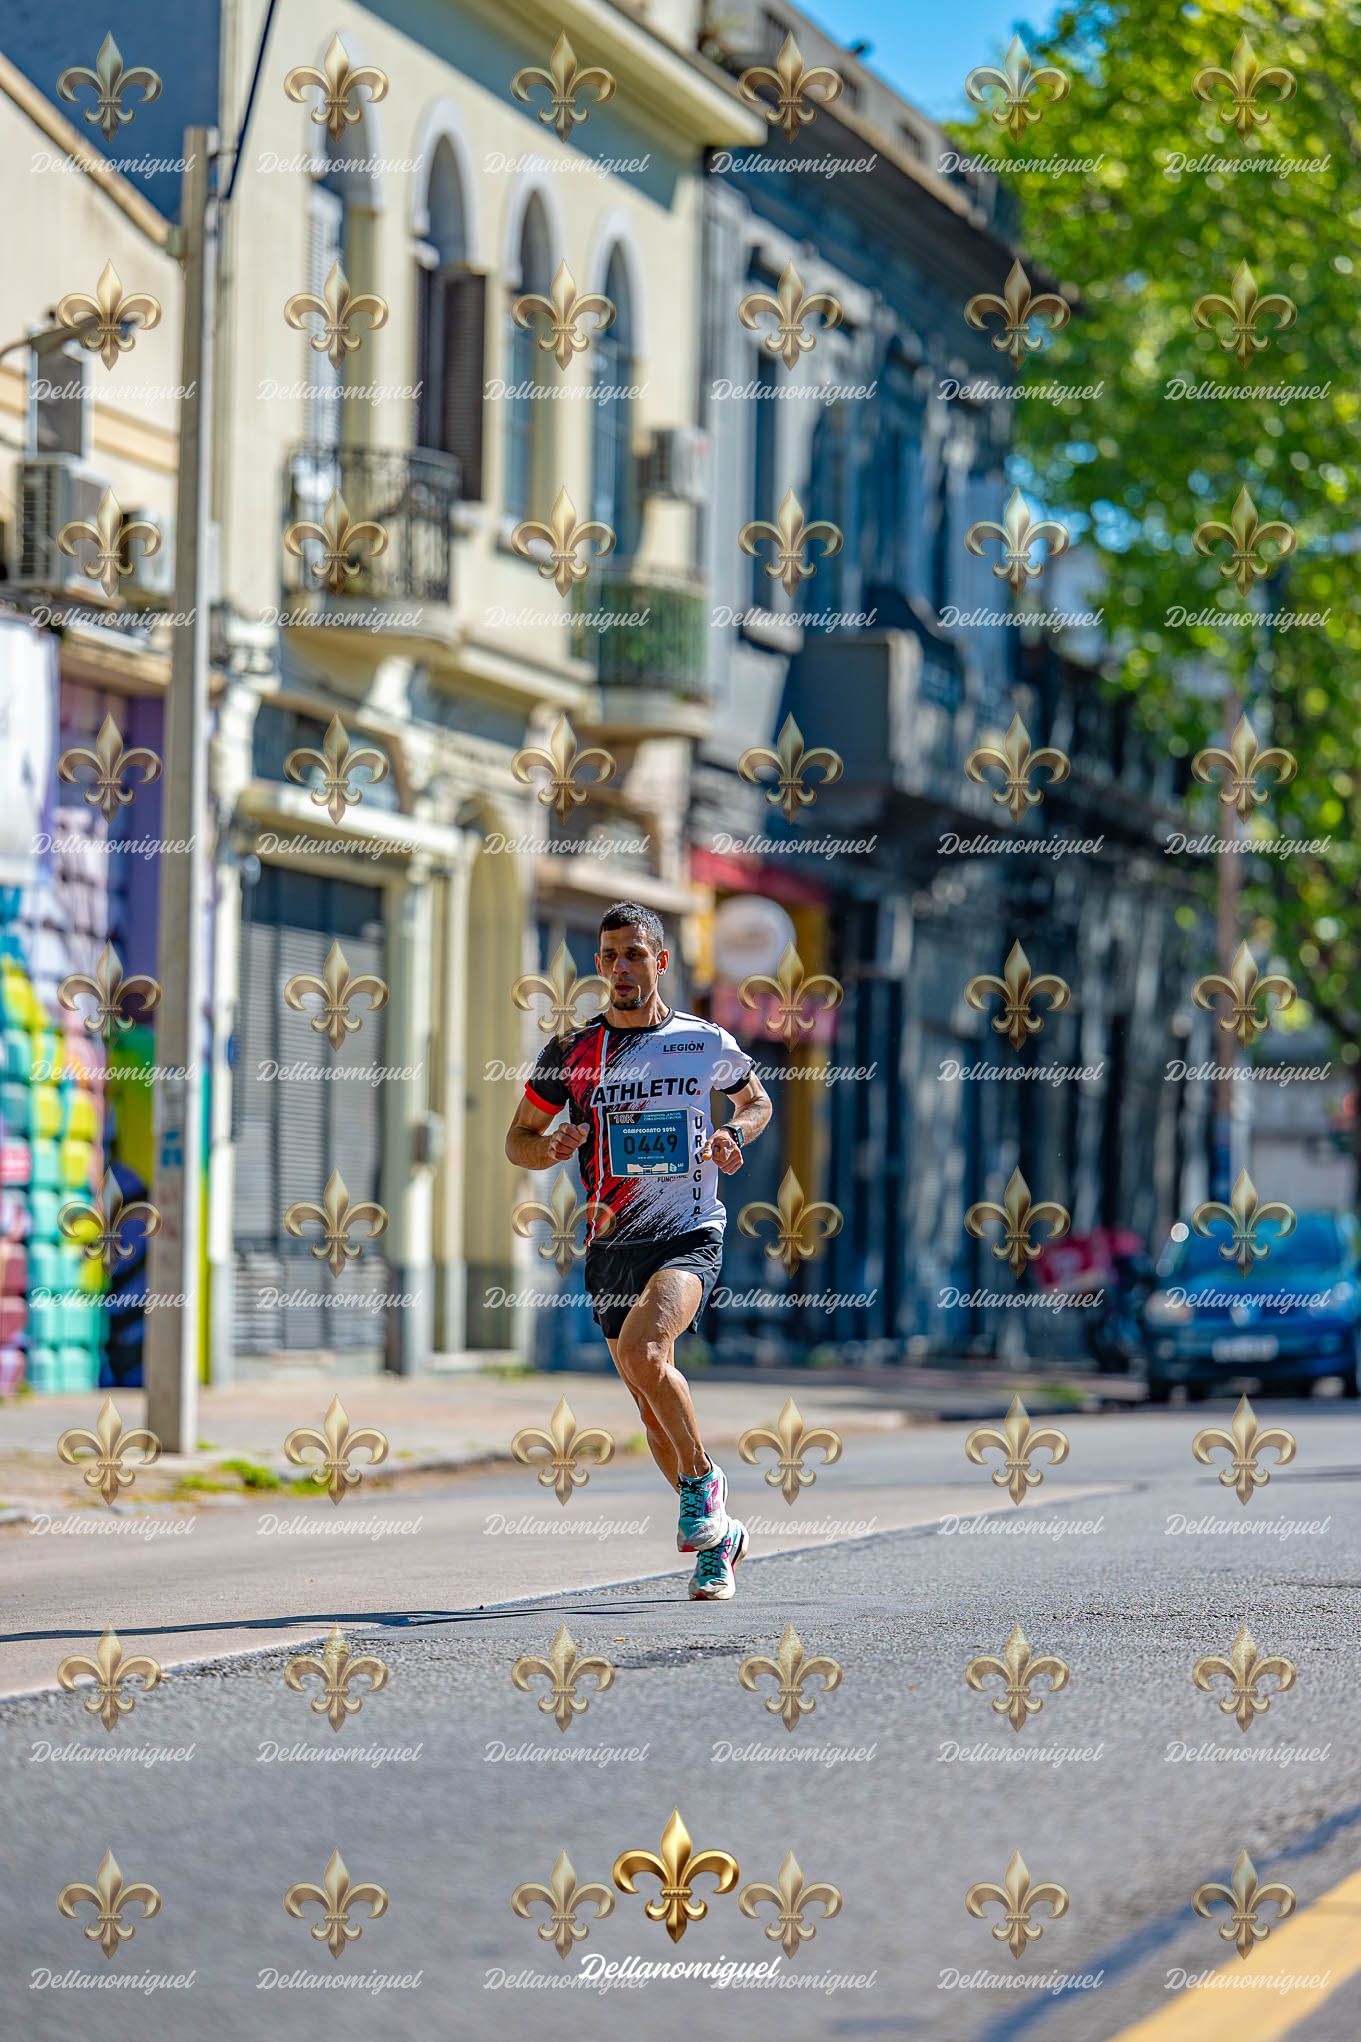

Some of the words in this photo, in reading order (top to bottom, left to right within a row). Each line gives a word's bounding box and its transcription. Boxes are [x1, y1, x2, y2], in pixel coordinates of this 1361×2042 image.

[613, 1114, 636, 1125] 10K
[623, 1133, 678, 1155] 0449
[691, 1115, 703, 1221] URUGUA
